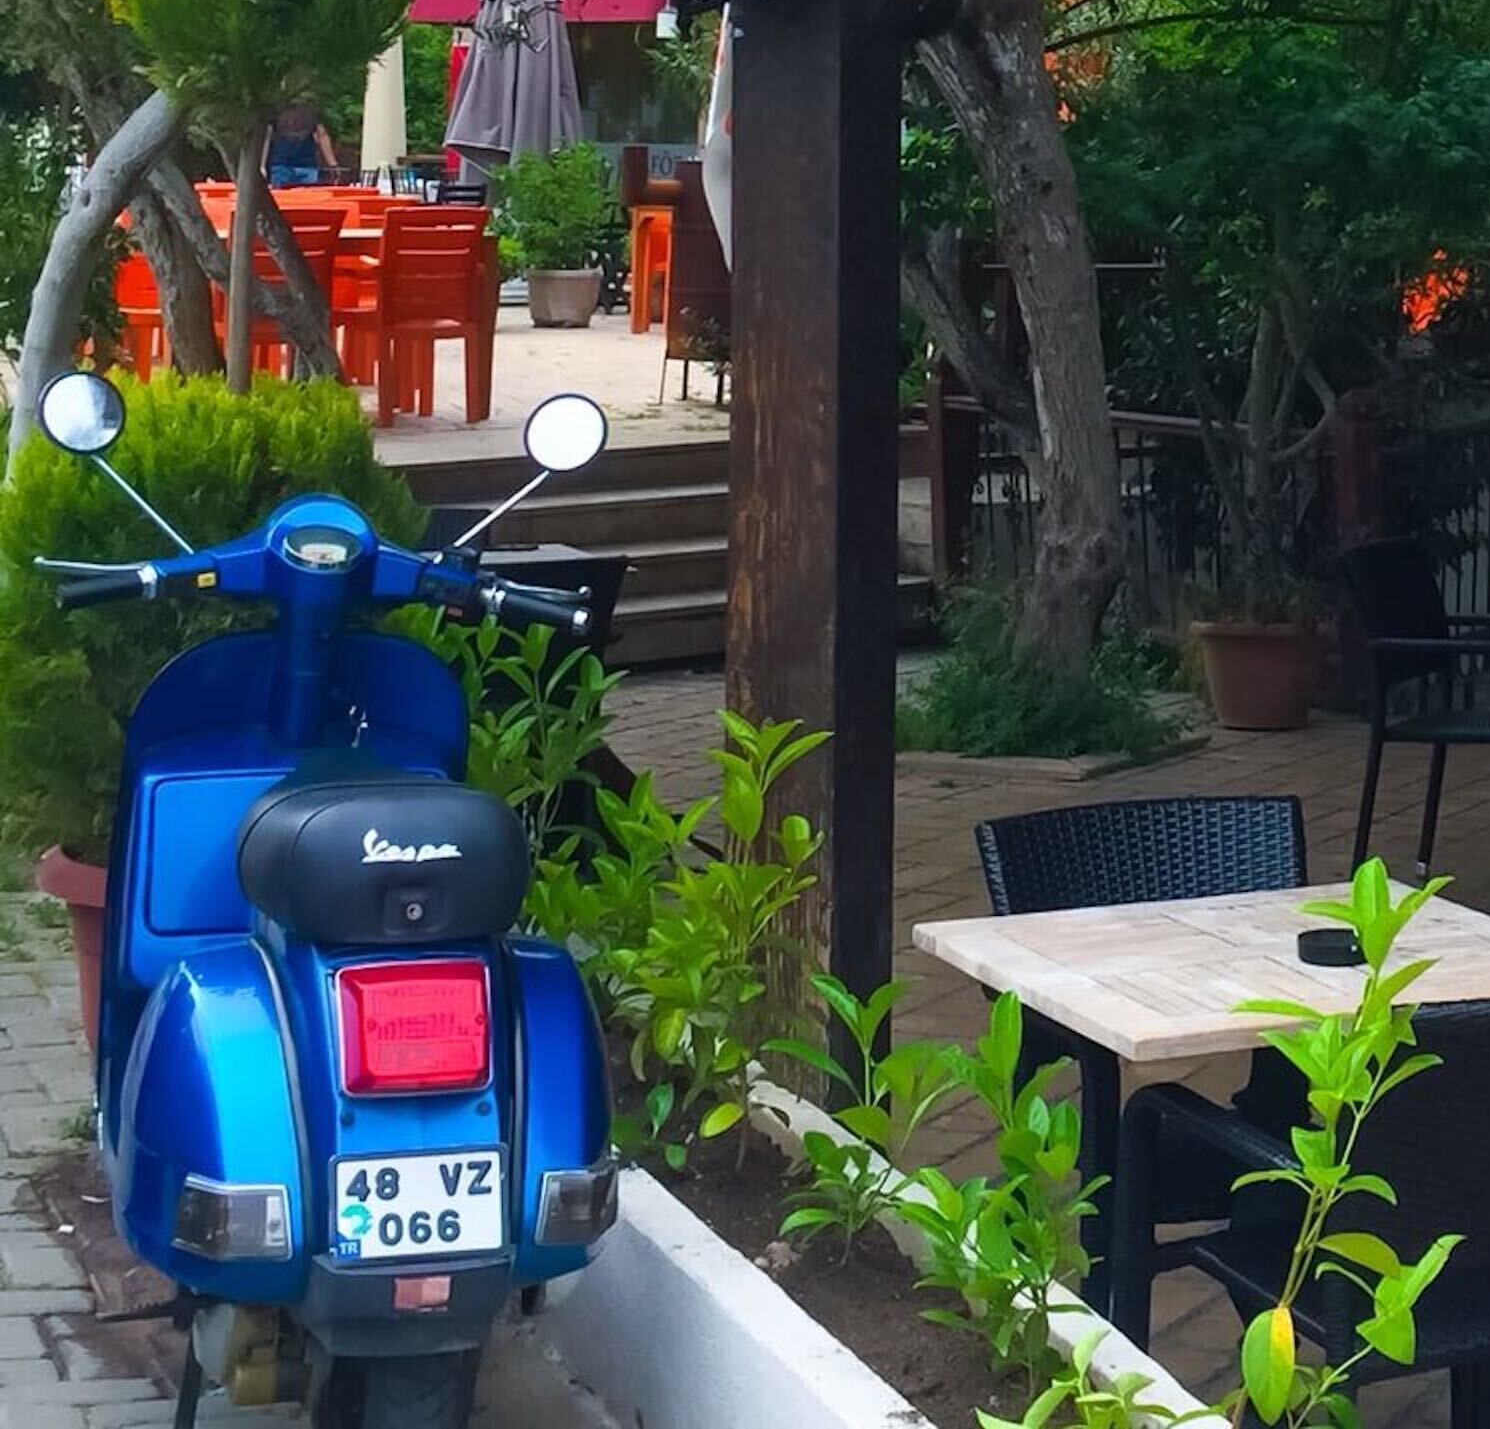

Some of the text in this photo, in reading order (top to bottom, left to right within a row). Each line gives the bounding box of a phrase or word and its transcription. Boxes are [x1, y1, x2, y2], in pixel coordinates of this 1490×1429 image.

[361, 827, 463, 864] Vespa
[346, 1160, 492, 1202] 48 VZ
[378, 1209, 461, 1246] 066
[339, 1240, 359, 1255] TR
